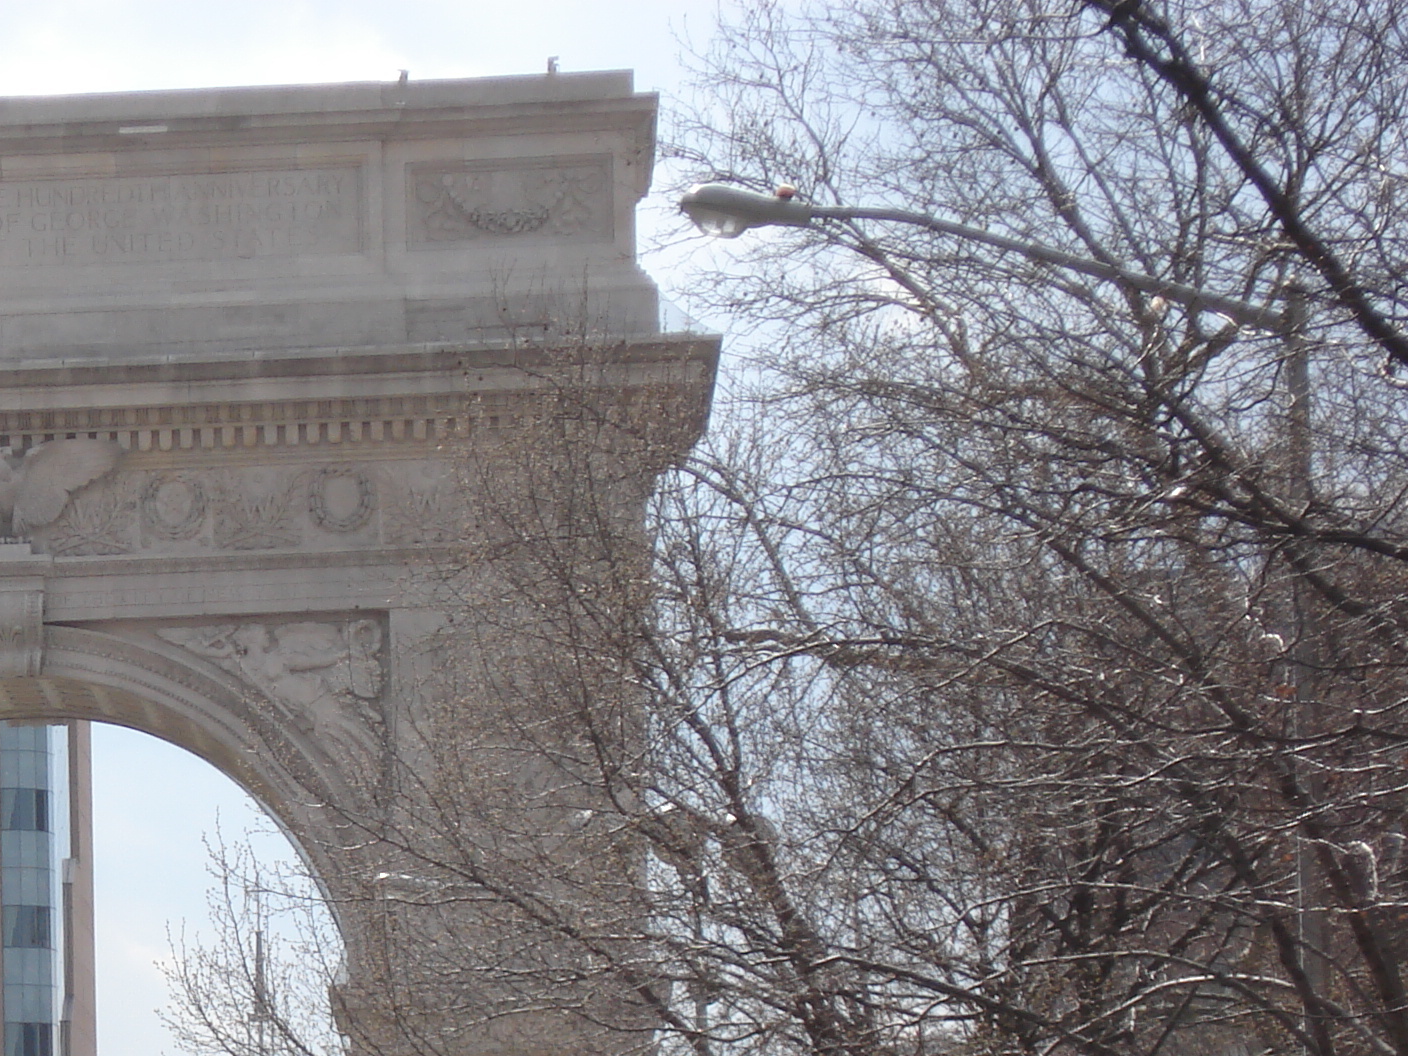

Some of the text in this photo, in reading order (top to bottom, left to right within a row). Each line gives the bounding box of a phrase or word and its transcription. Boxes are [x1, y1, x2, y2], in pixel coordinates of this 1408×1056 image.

[17, 183, 170, 208] HUNDREDTH
[176, 175, 344, 201] ANNIVERSARY
[31, 207, 137, 232] GEORGE
[152, 200, 342, 228] WASHINGTON
[22, 236, 77, 258] THE
[92, 231, 194, 256] UNITED
[212, 225, 319, 251] STATES
